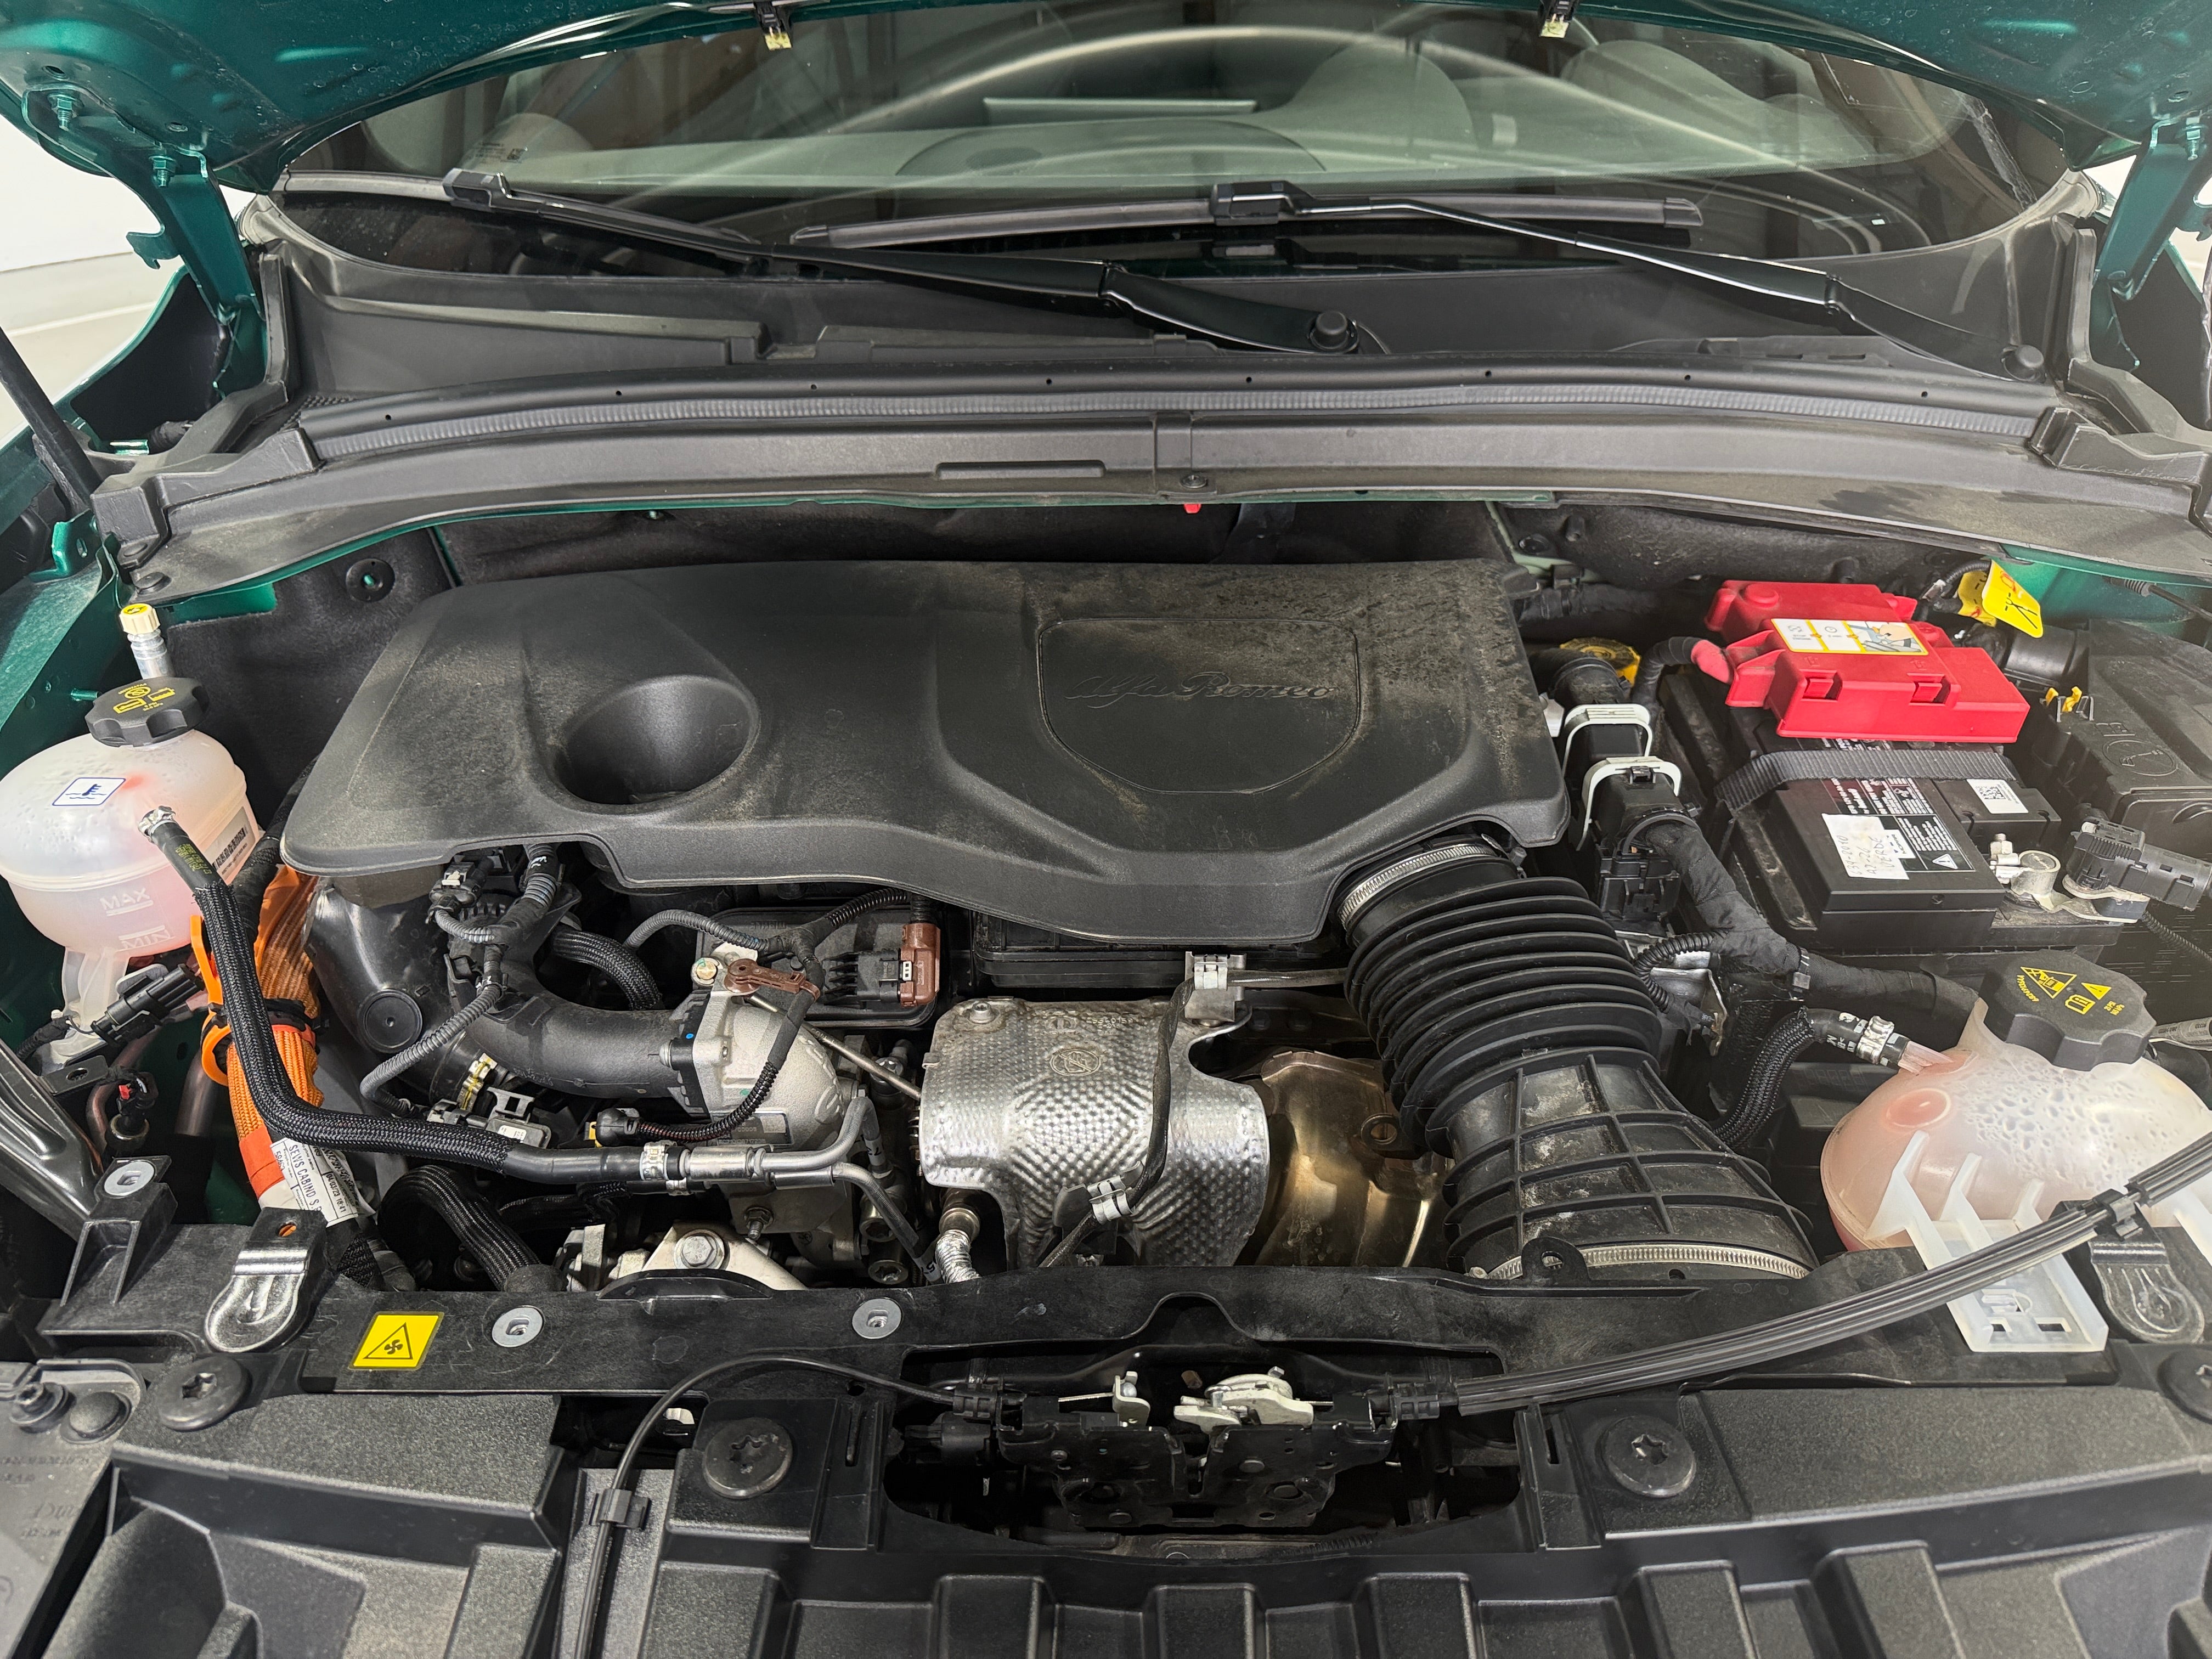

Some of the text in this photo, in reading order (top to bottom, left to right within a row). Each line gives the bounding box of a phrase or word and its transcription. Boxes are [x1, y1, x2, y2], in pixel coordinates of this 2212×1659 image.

[1064, 671, 1336, 709] Alfa Romeo
[1868, 835, 1895, 868] VERDE
[1891, 834, 1907, 854] MOPAR
[99, 887, 150, 910] MAX
[121, 929, 171, 949] MIN
[289, 1144, 305, 1169] SEWS
[297, 1168, 317, 1198] CABIND
